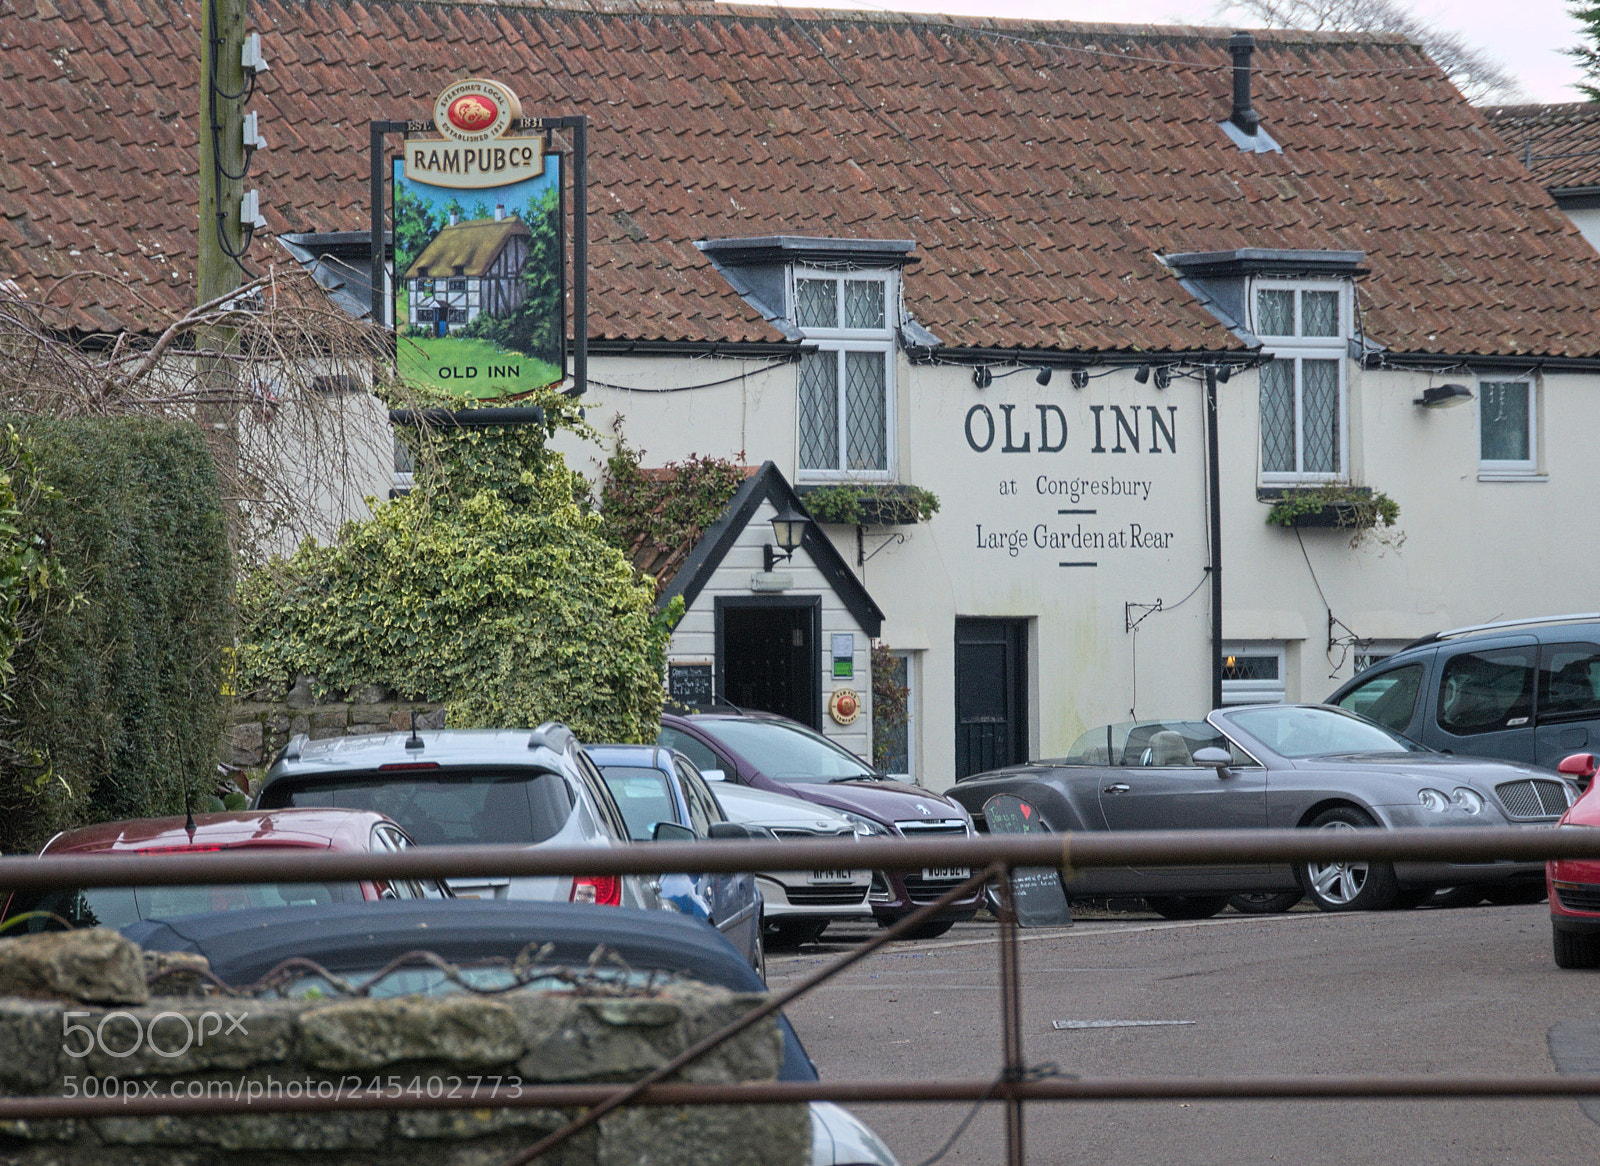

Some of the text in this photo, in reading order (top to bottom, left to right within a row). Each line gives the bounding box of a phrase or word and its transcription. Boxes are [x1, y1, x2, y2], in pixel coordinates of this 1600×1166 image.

[483, 86, 504, 106] LOCAL
[442, 122, 489, 142] ESTABLISHED
[520, 118, 543, 129] 1831
[438, 365, 520, 379] OLD INN
[964, 403, 1178, 454] OLD INN
[999, 475, 1153, 504] at Congresbury
[976, 523, 1174, 558] Large Garden at Rear
